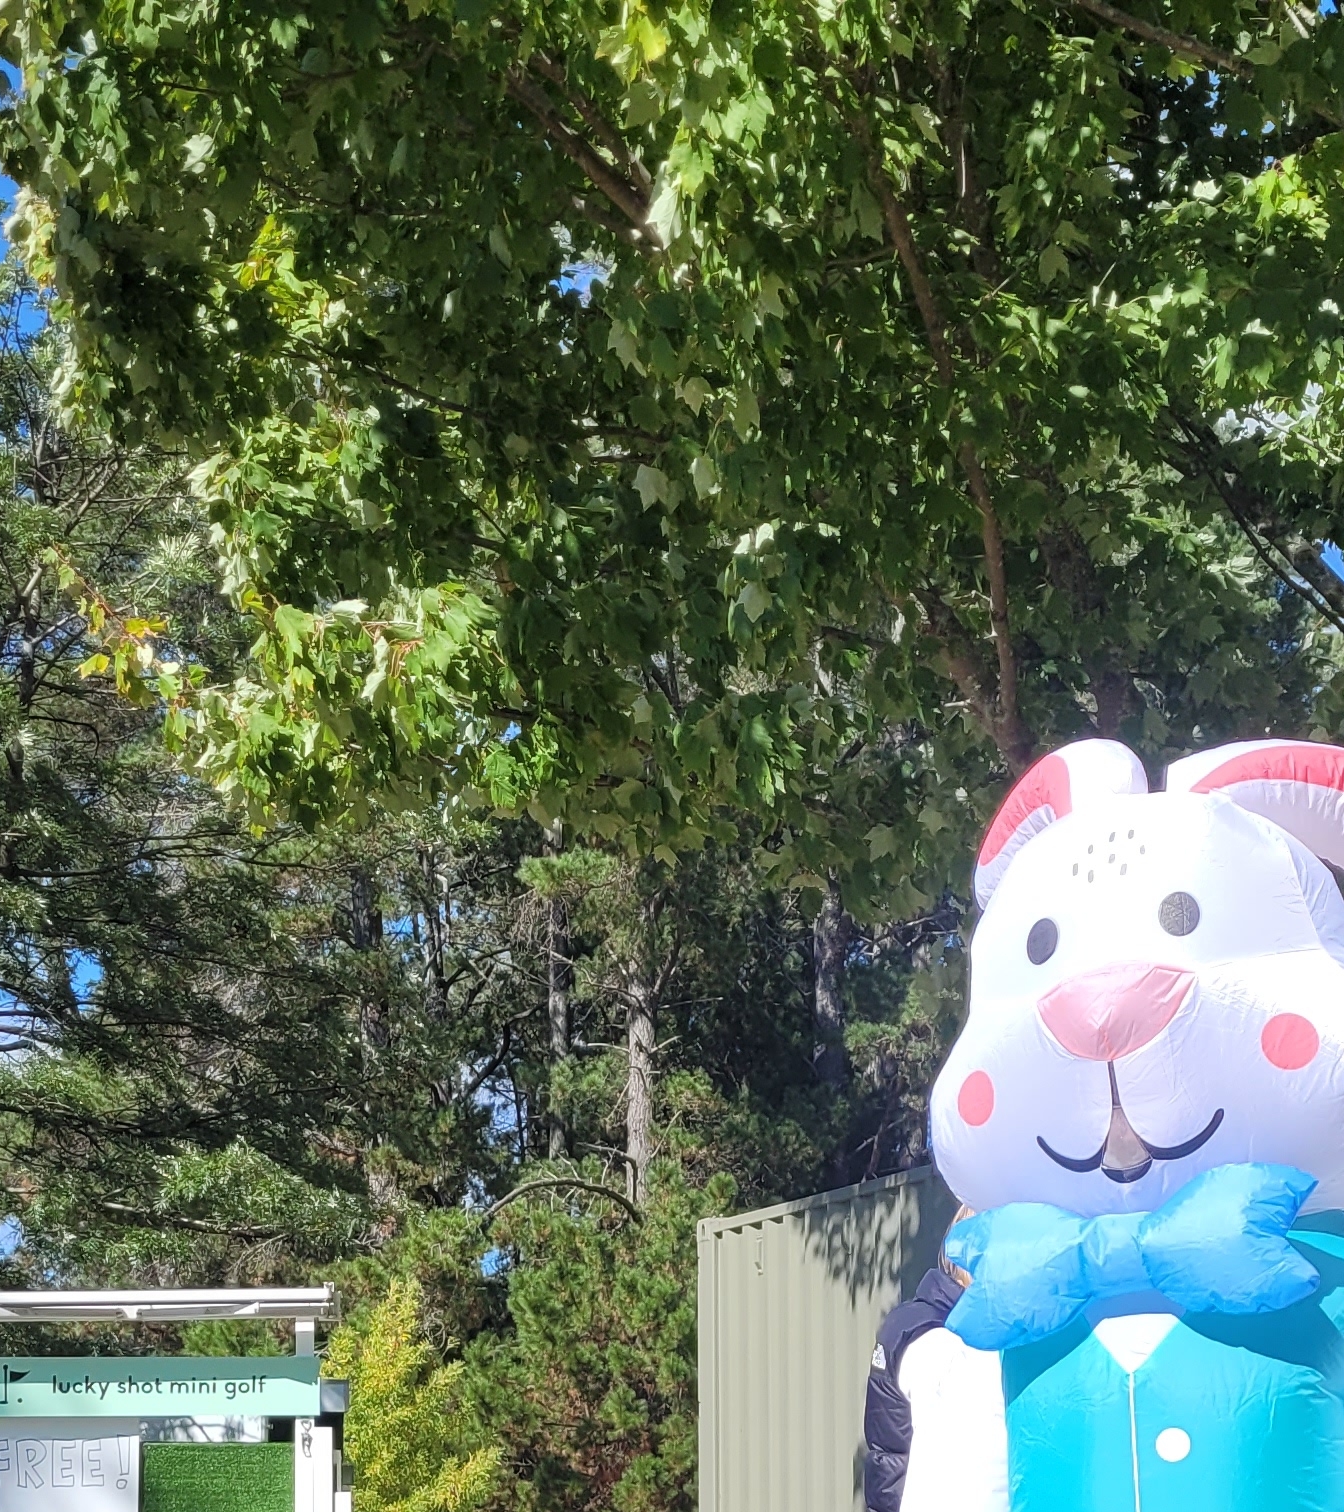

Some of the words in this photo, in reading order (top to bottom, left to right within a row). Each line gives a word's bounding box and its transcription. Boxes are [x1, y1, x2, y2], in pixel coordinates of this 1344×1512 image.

[52, 1375, 110, 1400] lucky
[117, 1375, 163, 1394] shot
[170, 1377, 217, 1394] mini
[224, 1375, 267, 1400] golf
